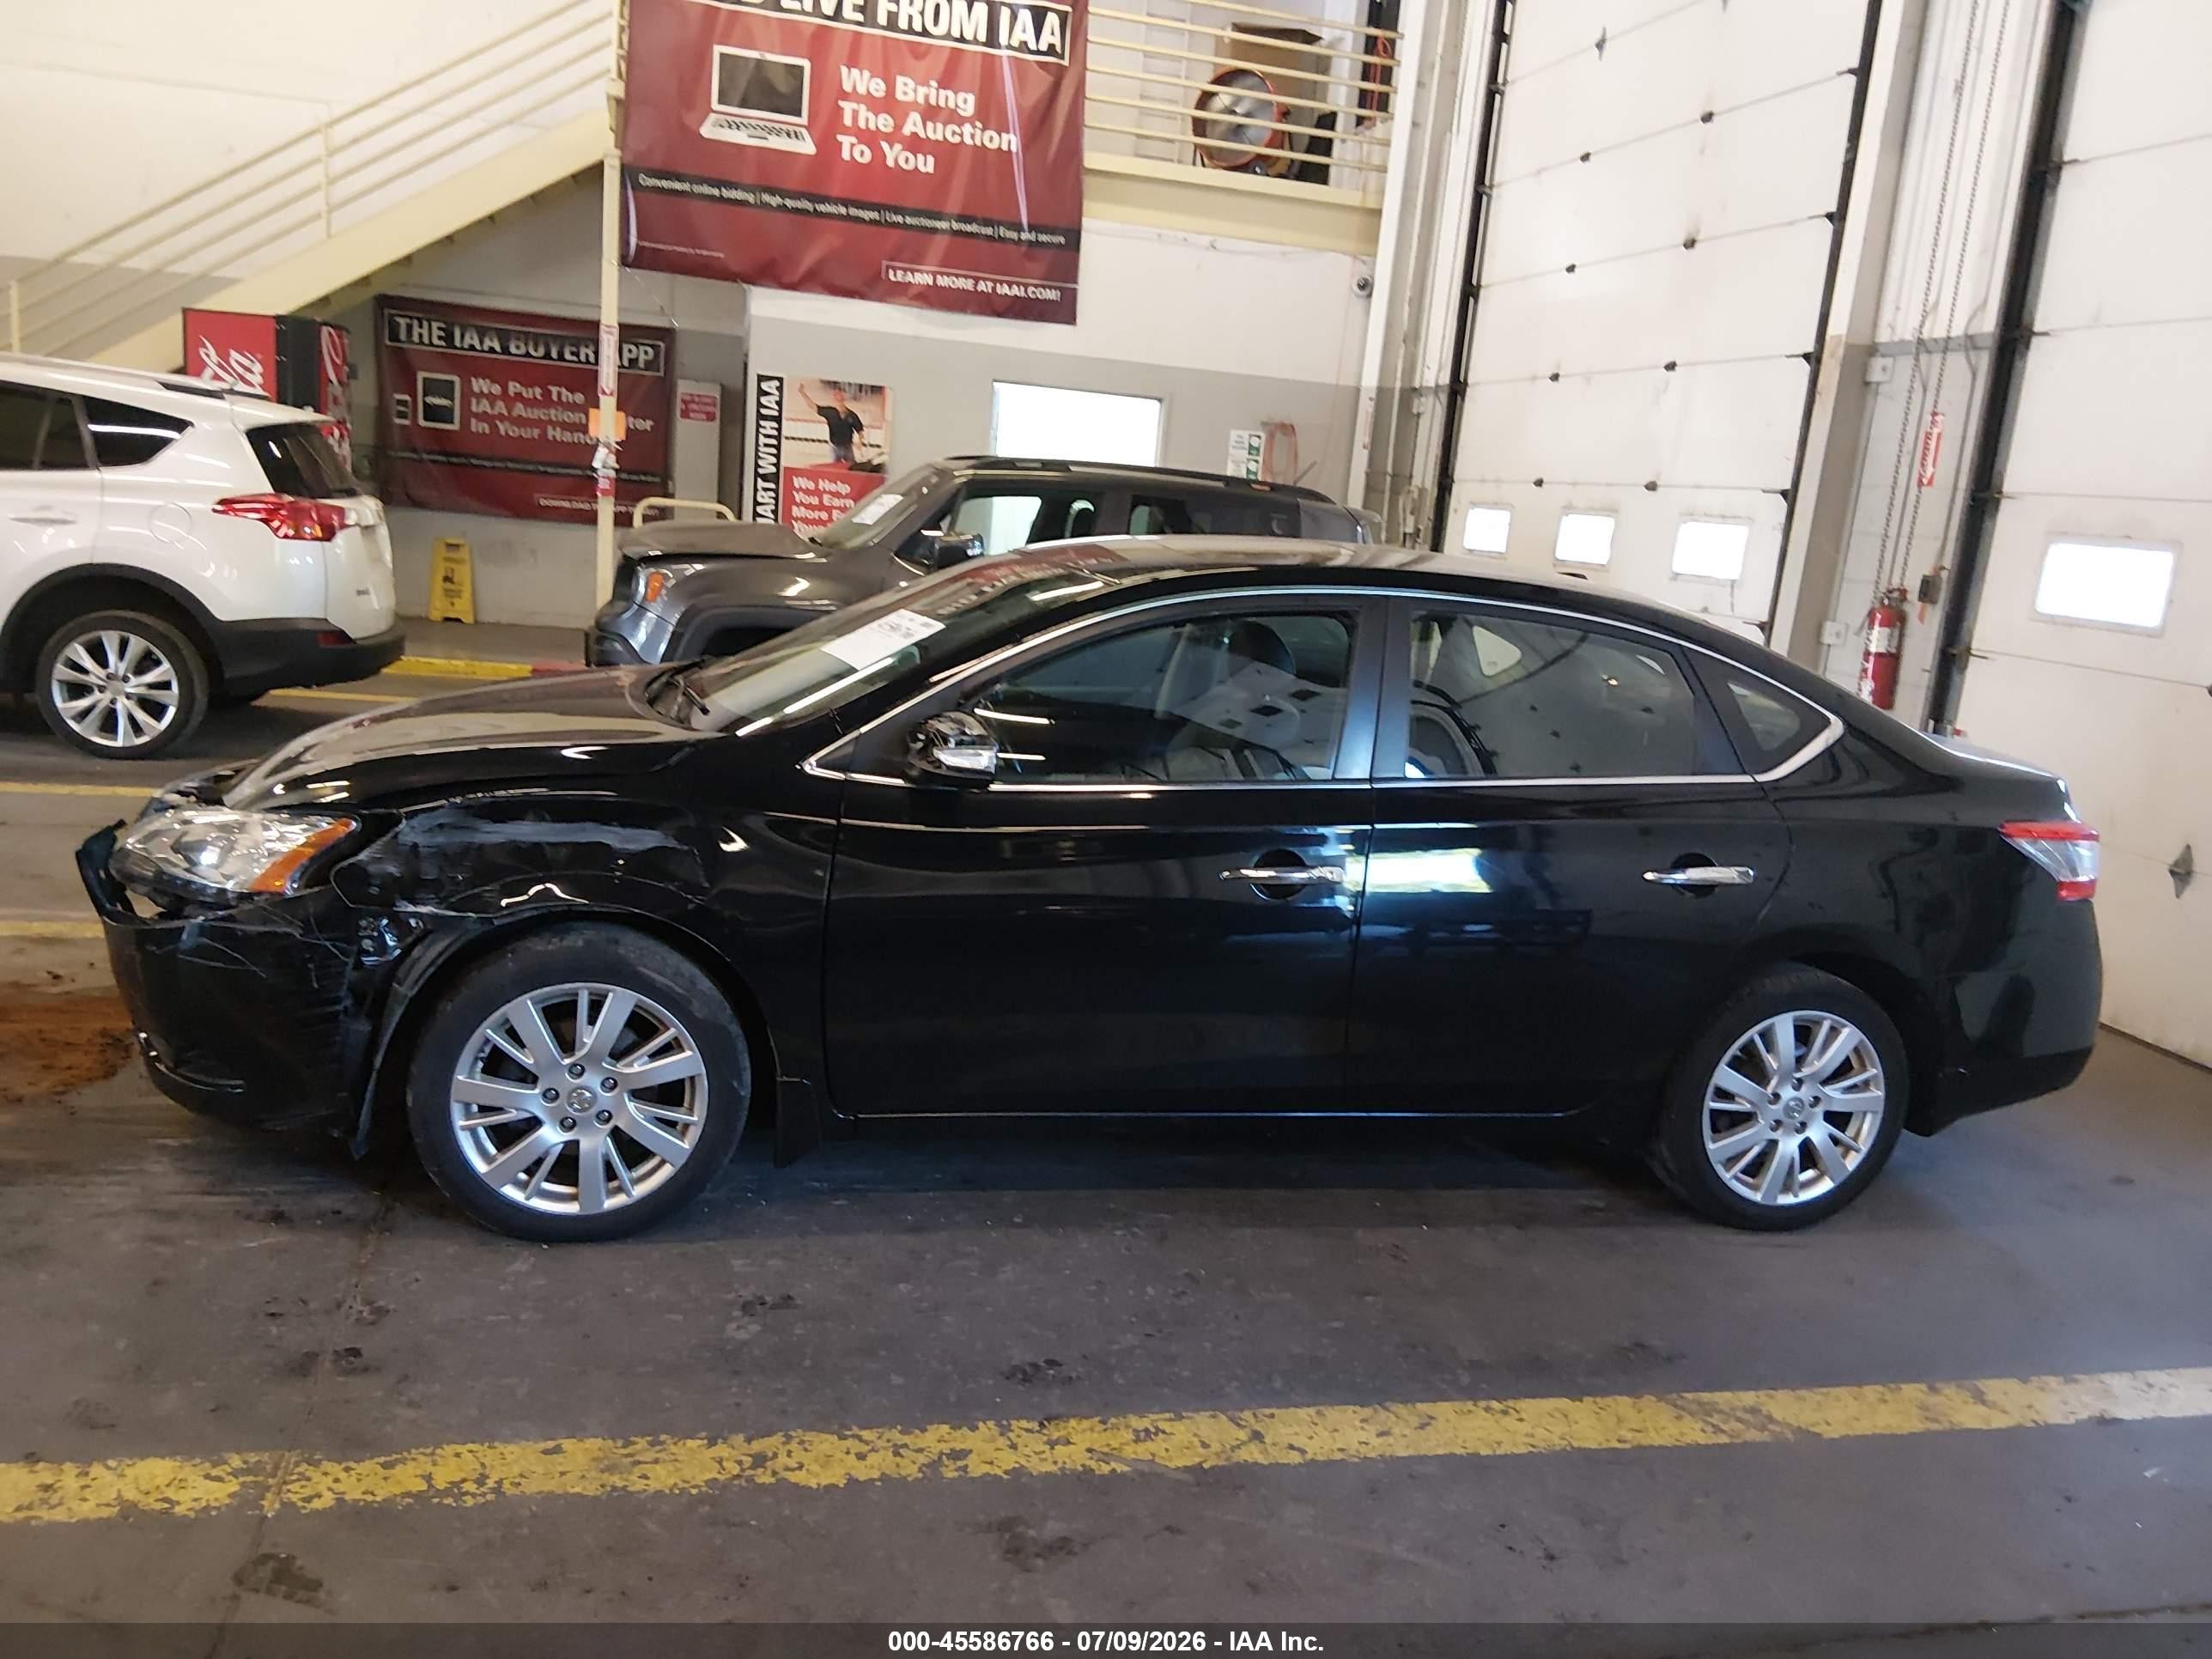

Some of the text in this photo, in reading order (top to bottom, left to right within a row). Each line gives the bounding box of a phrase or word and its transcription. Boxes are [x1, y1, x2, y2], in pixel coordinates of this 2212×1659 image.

[877, 0, 988, 42] FROM
[999, 5, 1062, 54] IAA
[839, 65, 975, 117] We Bring
[838, 100, 1017, 153] The Auction
[836, 134, 935, 173] To You
[888, 268, 933, 287] LEARN
[935, 274, 975, 292] MORE
[975, 279, 996, 295] AT
[393, 316, 447, 347] THE
[453, 325, 502, 354] IAA
[471, 376, 586, 405] We Put The
[759, 379, 781, 416] IAA
[470, 398, 509, 416] IAA
[512, 403, 587, 424] Auction
[470, 417, 491, 434] In
[495, 420, 543, 441] Your
[757, 419, 780, 475] WITH
[792, 475, 852, 495] We Help
[792, 490, 855, 508] You Earn
[791, 505, 829, 520] More
